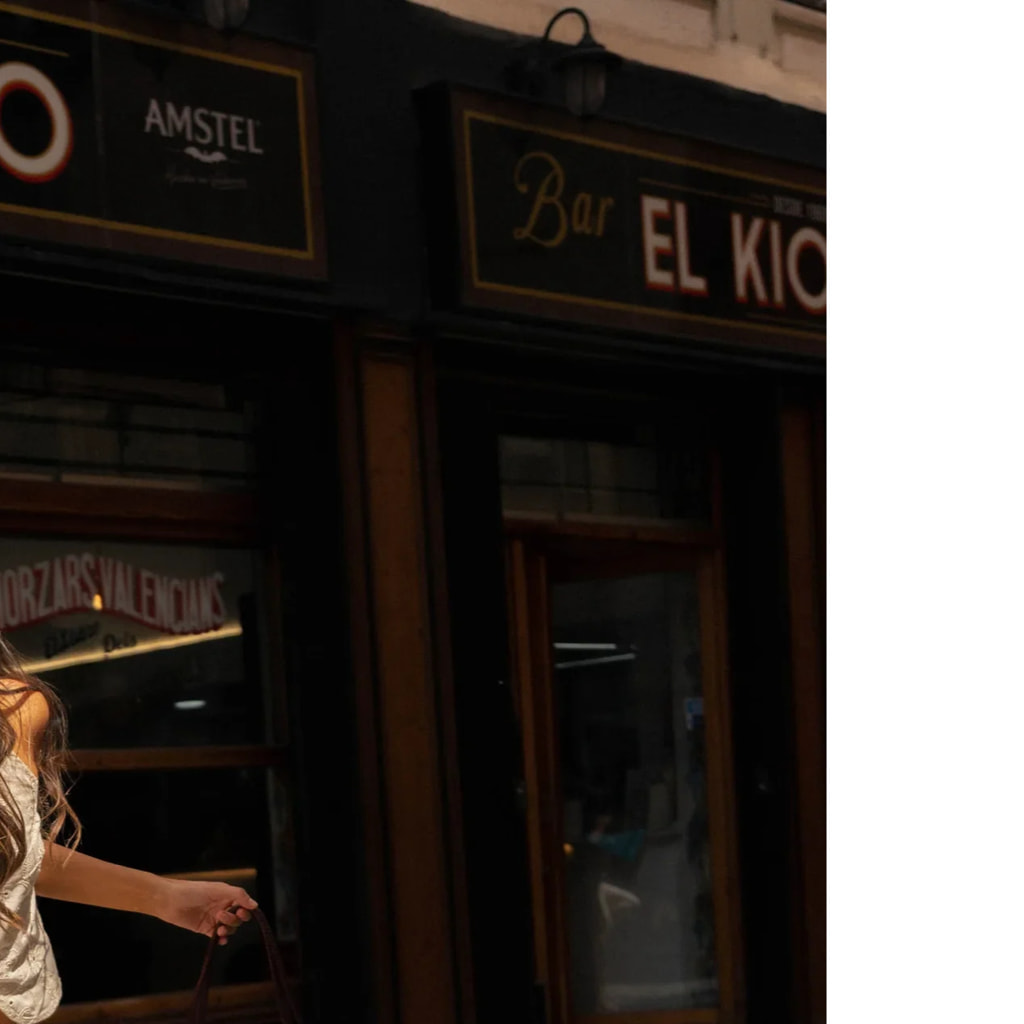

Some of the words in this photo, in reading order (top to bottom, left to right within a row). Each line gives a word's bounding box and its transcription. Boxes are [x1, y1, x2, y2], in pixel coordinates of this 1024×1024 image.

[144, 97, 264, 155] AMSTEL
[513, 151, 614, 248] Bar
[641, 195, 708, 296] EL
[730, 212, 826, 315] KIO
